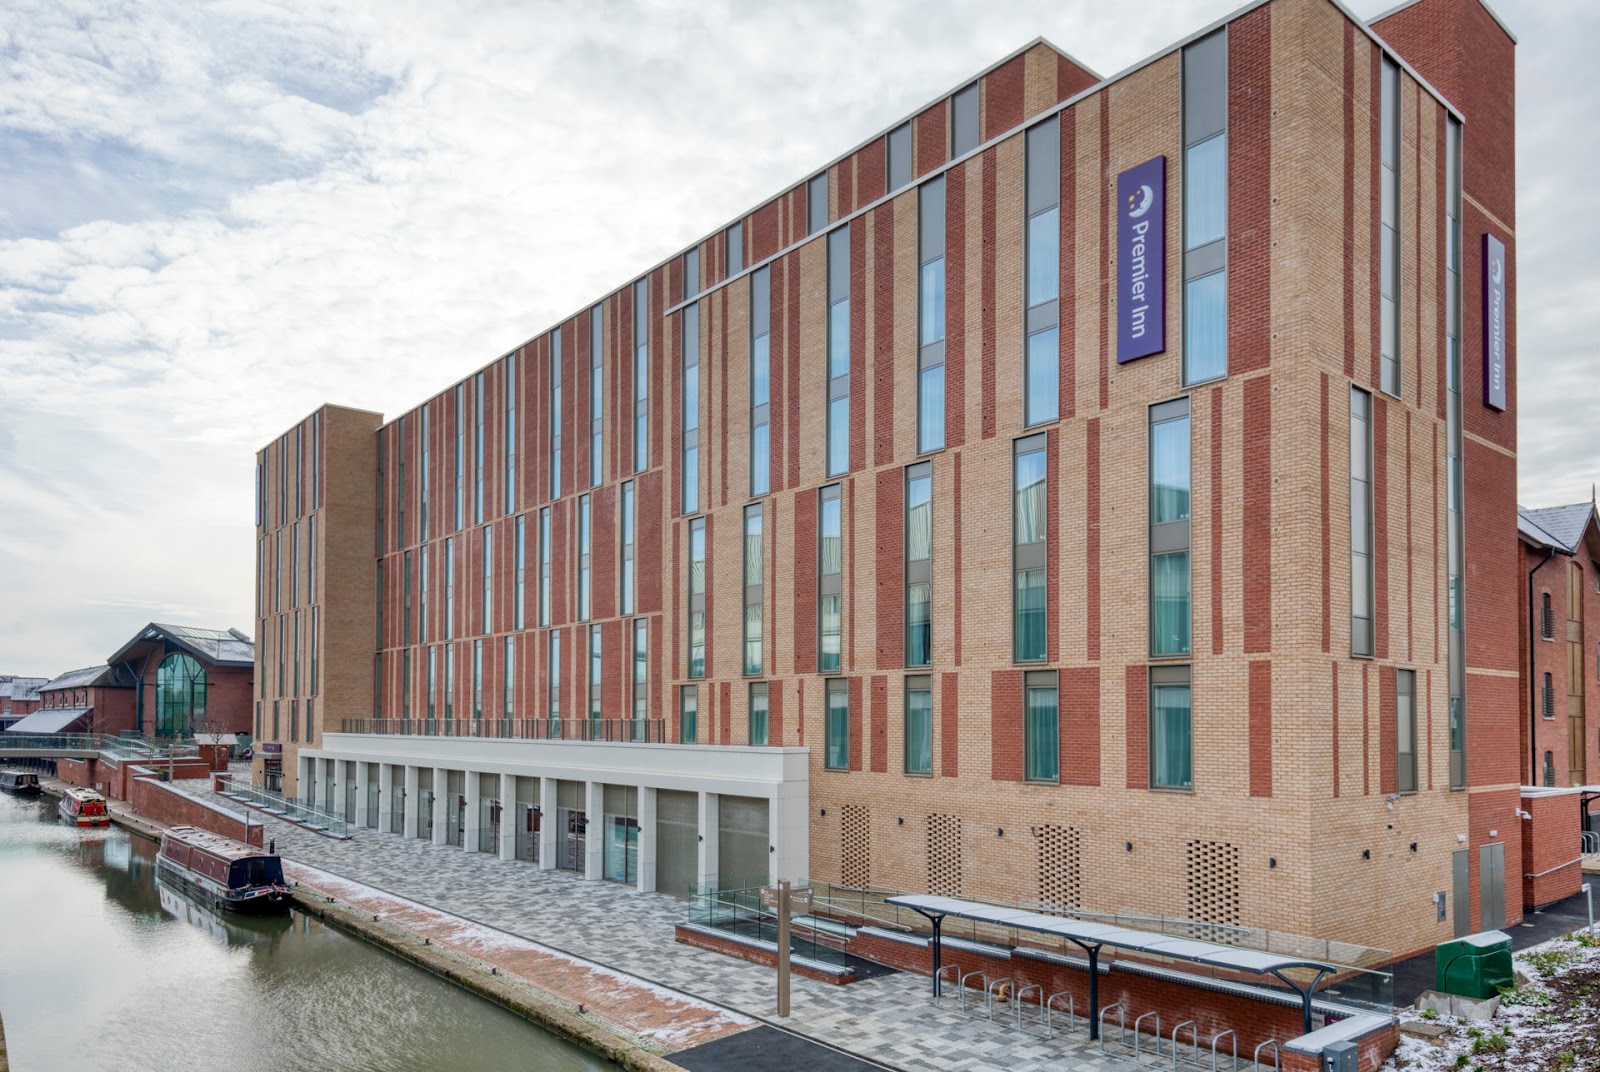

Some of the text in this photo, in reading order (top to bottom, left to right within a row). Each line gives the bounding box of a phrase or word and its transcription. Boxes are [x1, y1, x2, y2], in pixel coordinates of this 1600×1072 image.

[1132, 221, 1149, 339] Premier Inn
[1494, 362, 1502, 391] Inn
